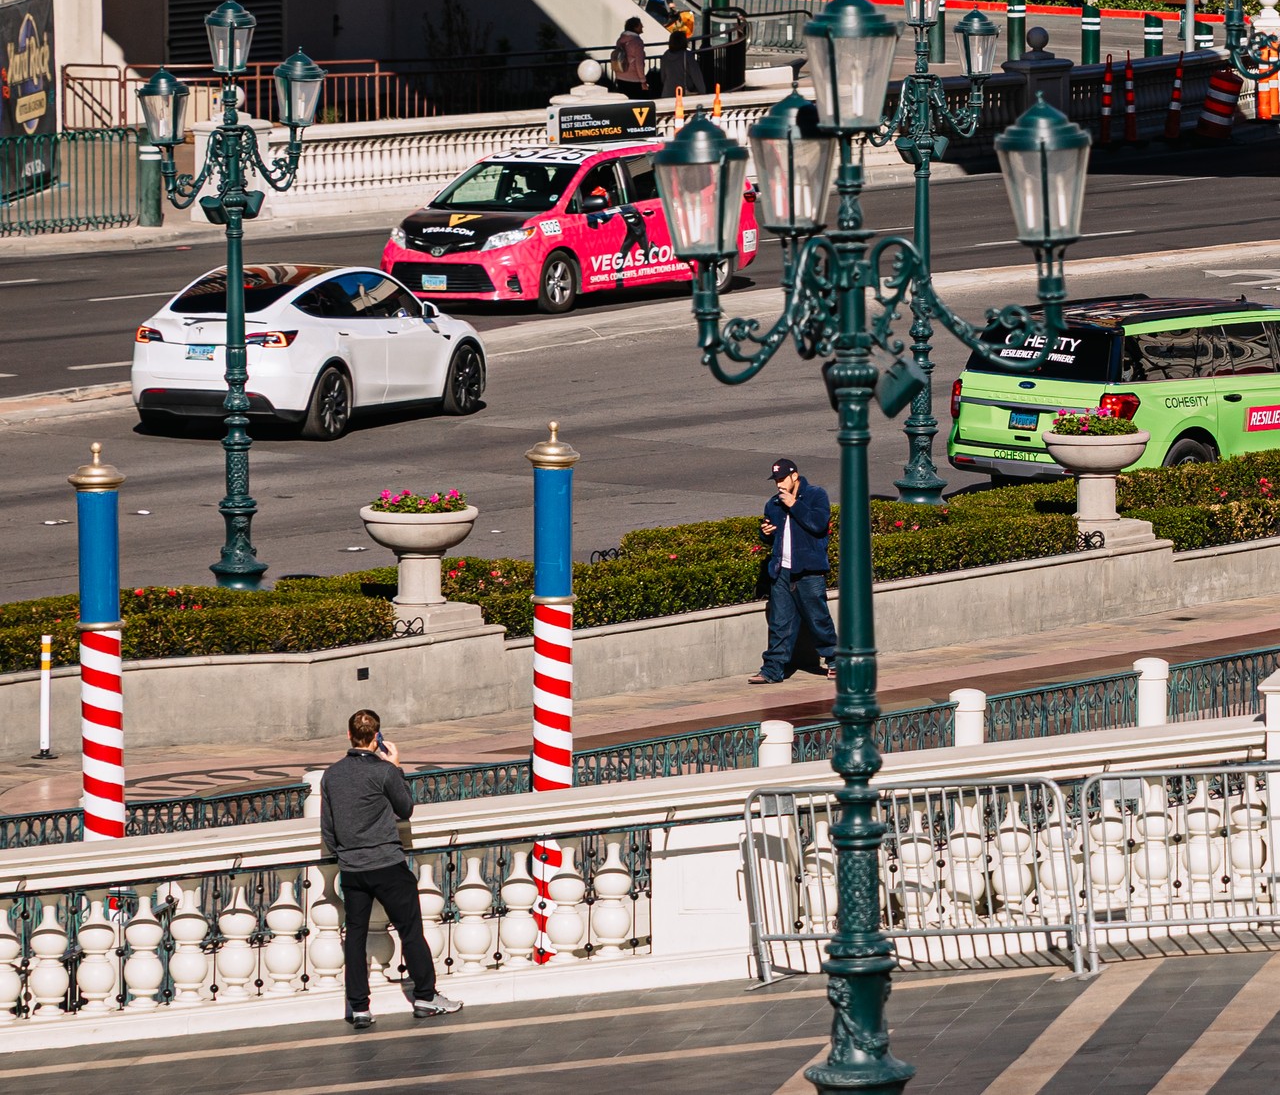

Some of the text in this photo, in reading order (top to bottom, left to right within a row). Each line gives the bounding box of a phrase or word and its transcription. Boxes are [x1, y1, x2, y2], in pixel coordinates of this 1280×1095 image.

[562, 126, 622, 138] ALL THINGS VEGAS
[422, 227, 476, 236] VEGAS.COM
[590, 244, 677, 272] VEGAS.CO
[1165, 395, 1209, 409] COHESITY
[994, 449, 1038, 462] COHESITY
